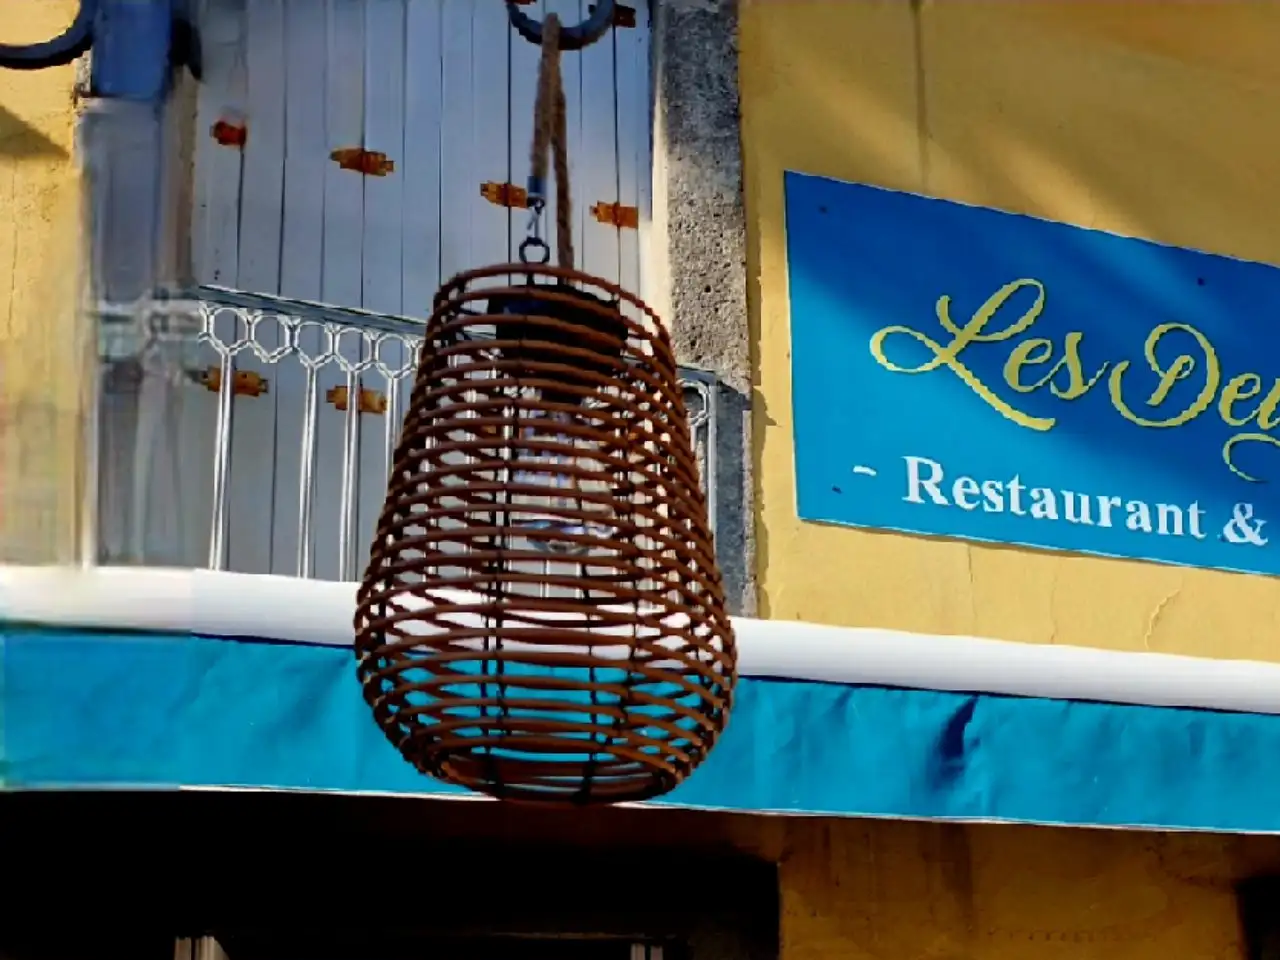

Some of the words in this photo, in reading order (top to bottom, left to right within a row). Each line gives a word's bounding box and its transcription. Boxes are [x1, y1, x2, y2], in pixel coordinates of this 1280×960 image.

[869, 277, 1108, 431] Les
[901, 454, 1206, 539] Restaurant
[1221, 501, 1269, 547] &
